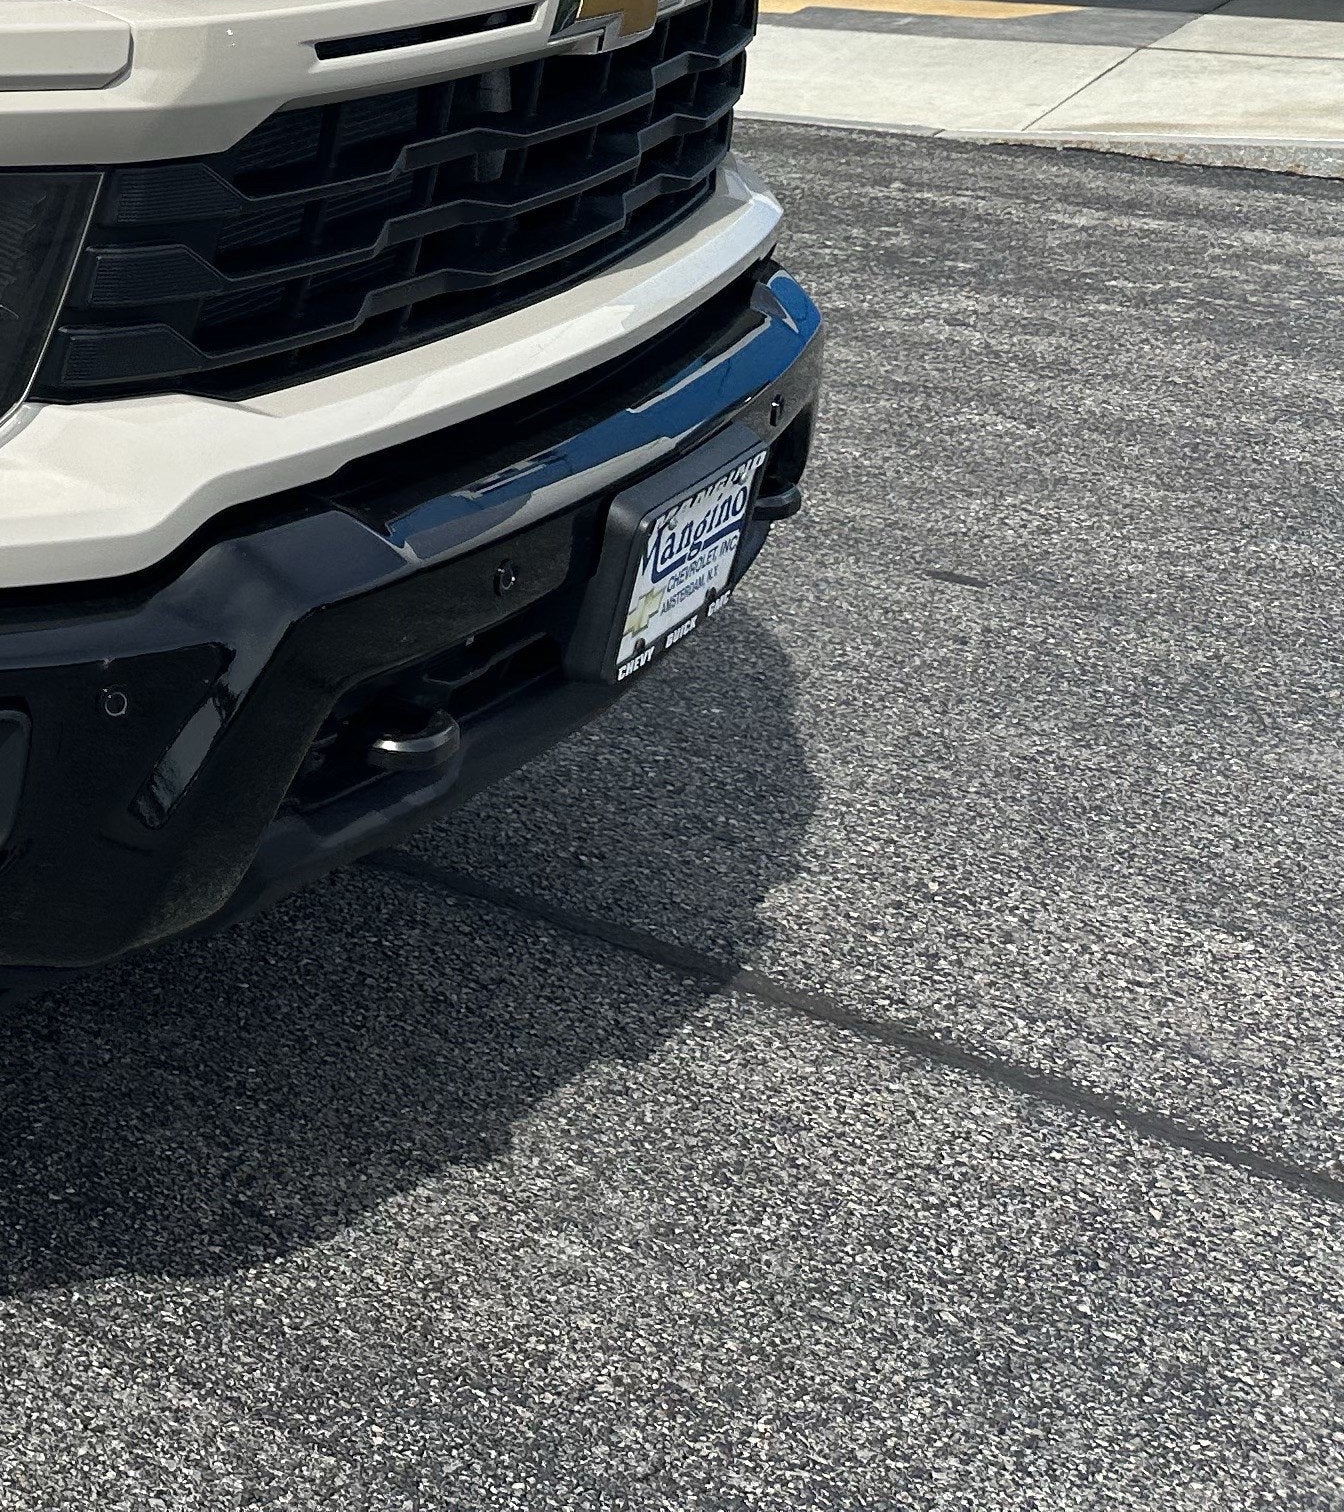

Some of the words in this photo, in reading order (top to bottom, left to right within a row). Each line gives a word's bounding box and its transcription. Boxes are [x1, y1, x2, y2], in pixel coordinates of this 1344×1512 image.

[617, 645, 656, 681] CHEVY
[665, 614, 699, 649] BUICK
[707, 589, 731, 618] GMC
